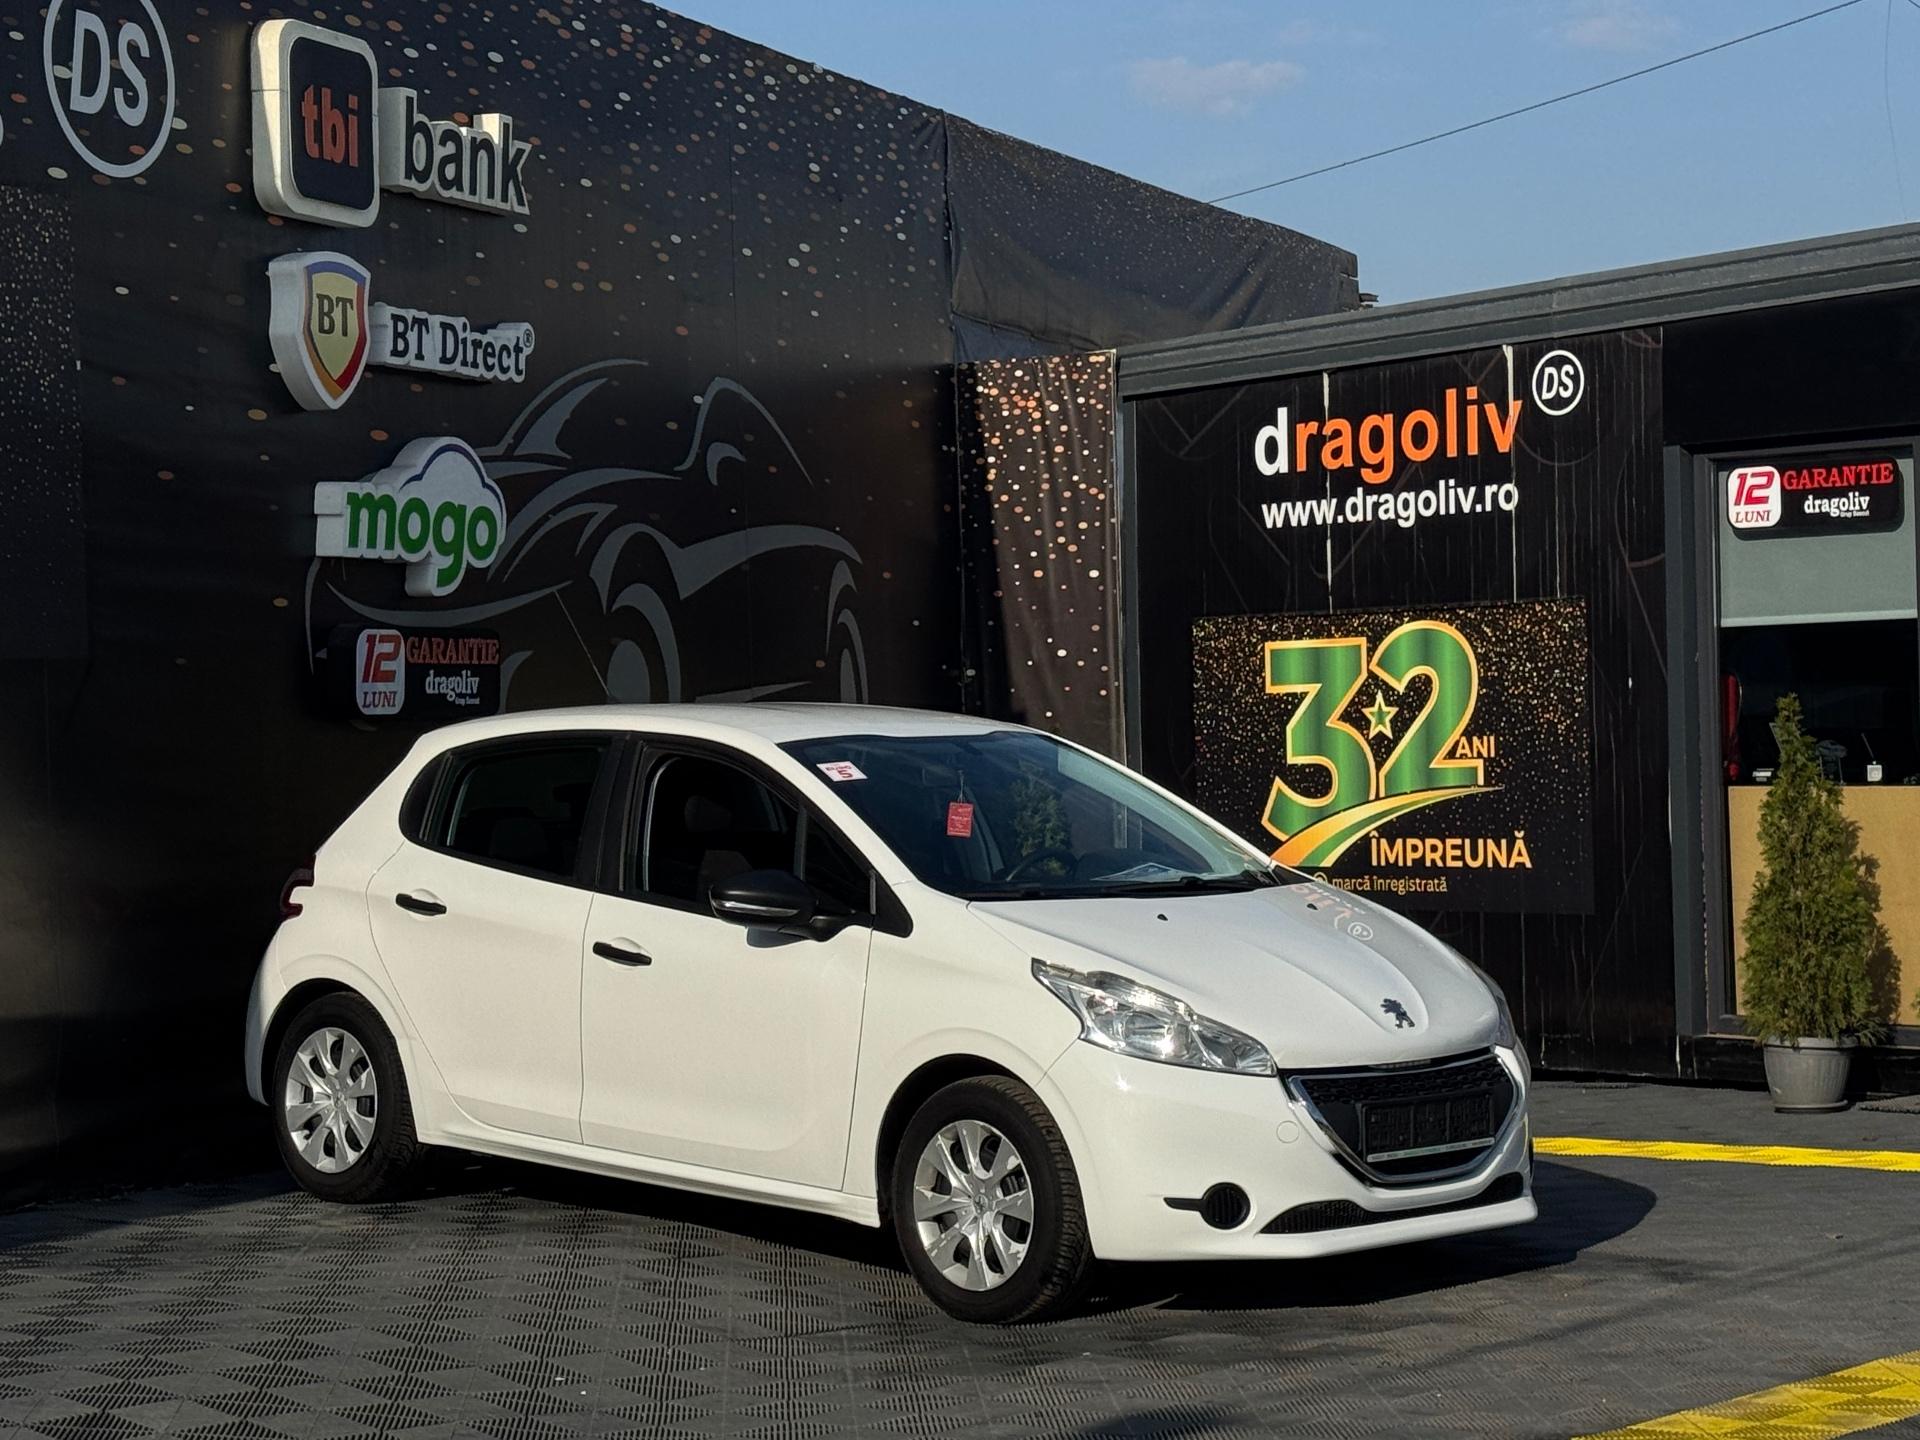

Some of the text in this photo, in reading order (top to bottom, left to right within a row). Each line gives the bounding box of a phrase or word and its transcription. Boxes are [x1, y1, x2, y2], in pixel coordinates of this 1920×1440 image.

[70, 9, 150, 127] DS
[302, 84, 531, 207] tbi bank
[315, 293, 354, 337] BT
[390, 313, 430, 361] BT
[1541, 365, 1574, 400] DS
[1254, 386, 1523, 484] dragoliv
[1733, 471, 1775, 506] 12
[1783, 463, 1894, 490] GARANTIE
[1261, 479, 1519, 528] www.dragoliv.ro
[1734, 510, 1770, 523] LUNI
[1804, 491, 1870, 517] dragoliv
[347, 490, 498, 588] mogo
[362, 634, 400, 683] 12
[406, 636, 499, 664] GARANTIE
[363, 690, 398, 709] LUNI
[425, 669, 480, 701] dragoliv
[1261, 620, 1495, 842] 32 ANI
[1370, 830, 1533, 869] ÎMPREUNĂ
[1331, 875, 1448, 896] marcă înregistrată
